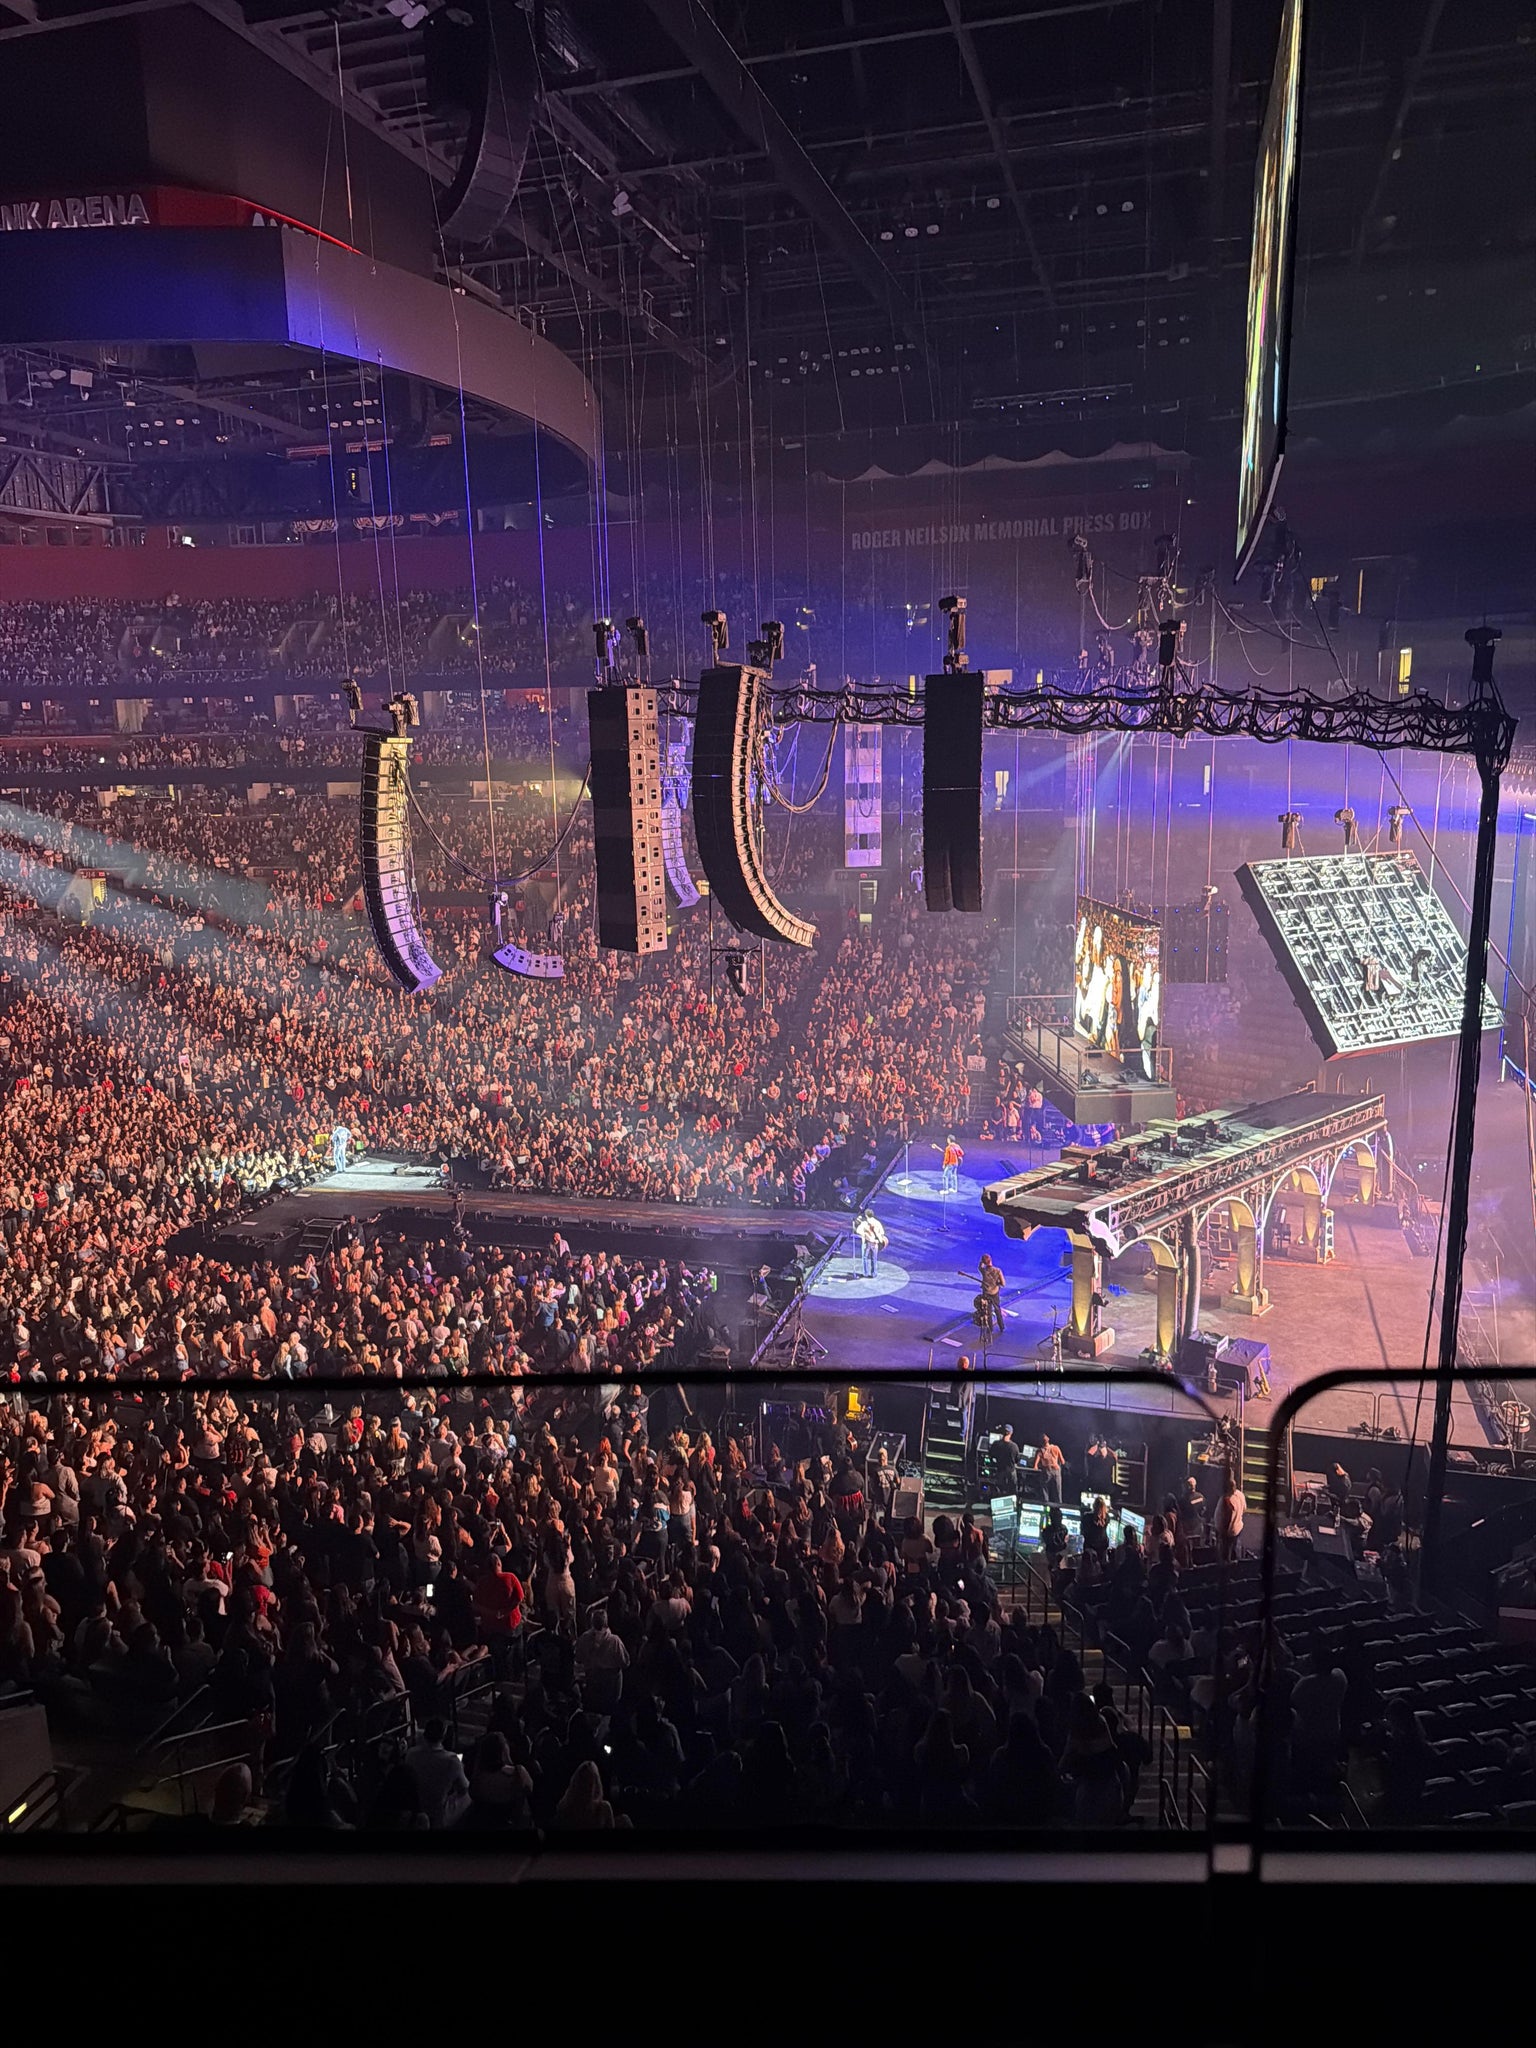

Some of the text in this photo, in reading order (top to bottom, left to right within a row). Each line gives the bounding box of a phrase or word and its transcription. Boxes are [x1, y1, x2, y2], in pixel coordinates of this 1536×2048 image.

[0, 193, 150, 230] NK ARENA
[852, 529, 901, 550] ROGER
[904, 523, 970, 546] NEILSON
[974, 517, 1059, 542] MEMORIAL
[1062, 512, 1114, 535] PRESS
